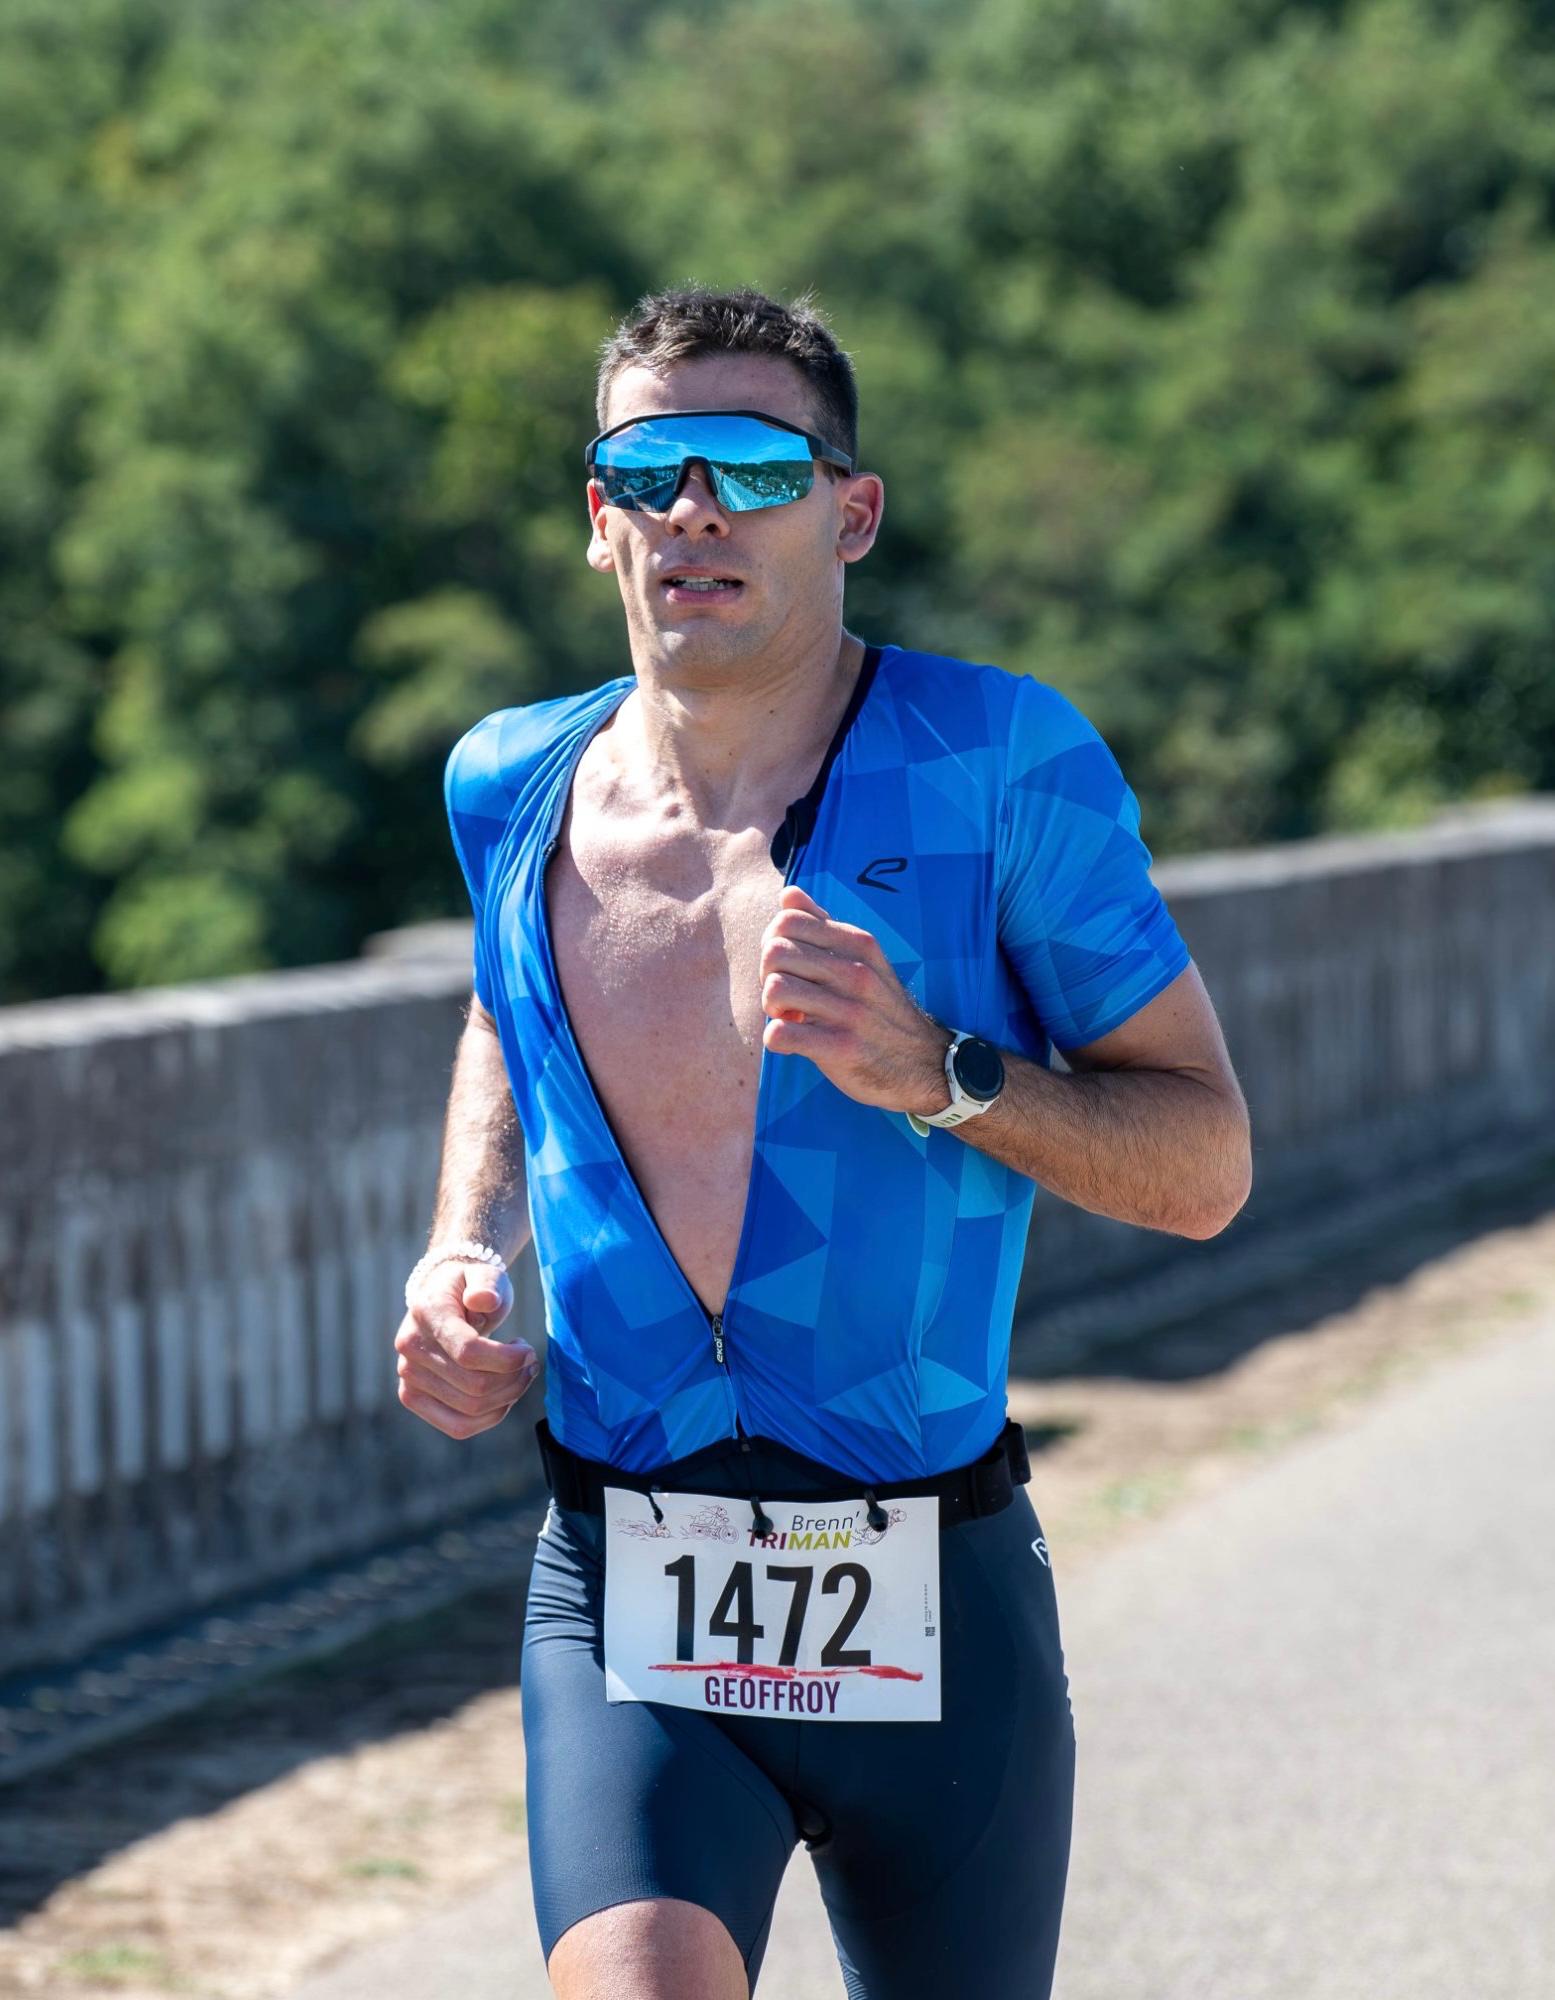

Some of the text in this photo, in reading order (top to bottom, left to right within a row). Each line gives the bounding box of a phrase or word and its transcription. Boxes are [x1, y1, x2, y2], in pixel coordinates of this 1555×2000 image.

[791, 1511, 860, 1531] Brenn'
[664, 1554, 872, 1667] 1472
[704, 1676, 840, 1714] GEOFFROY
